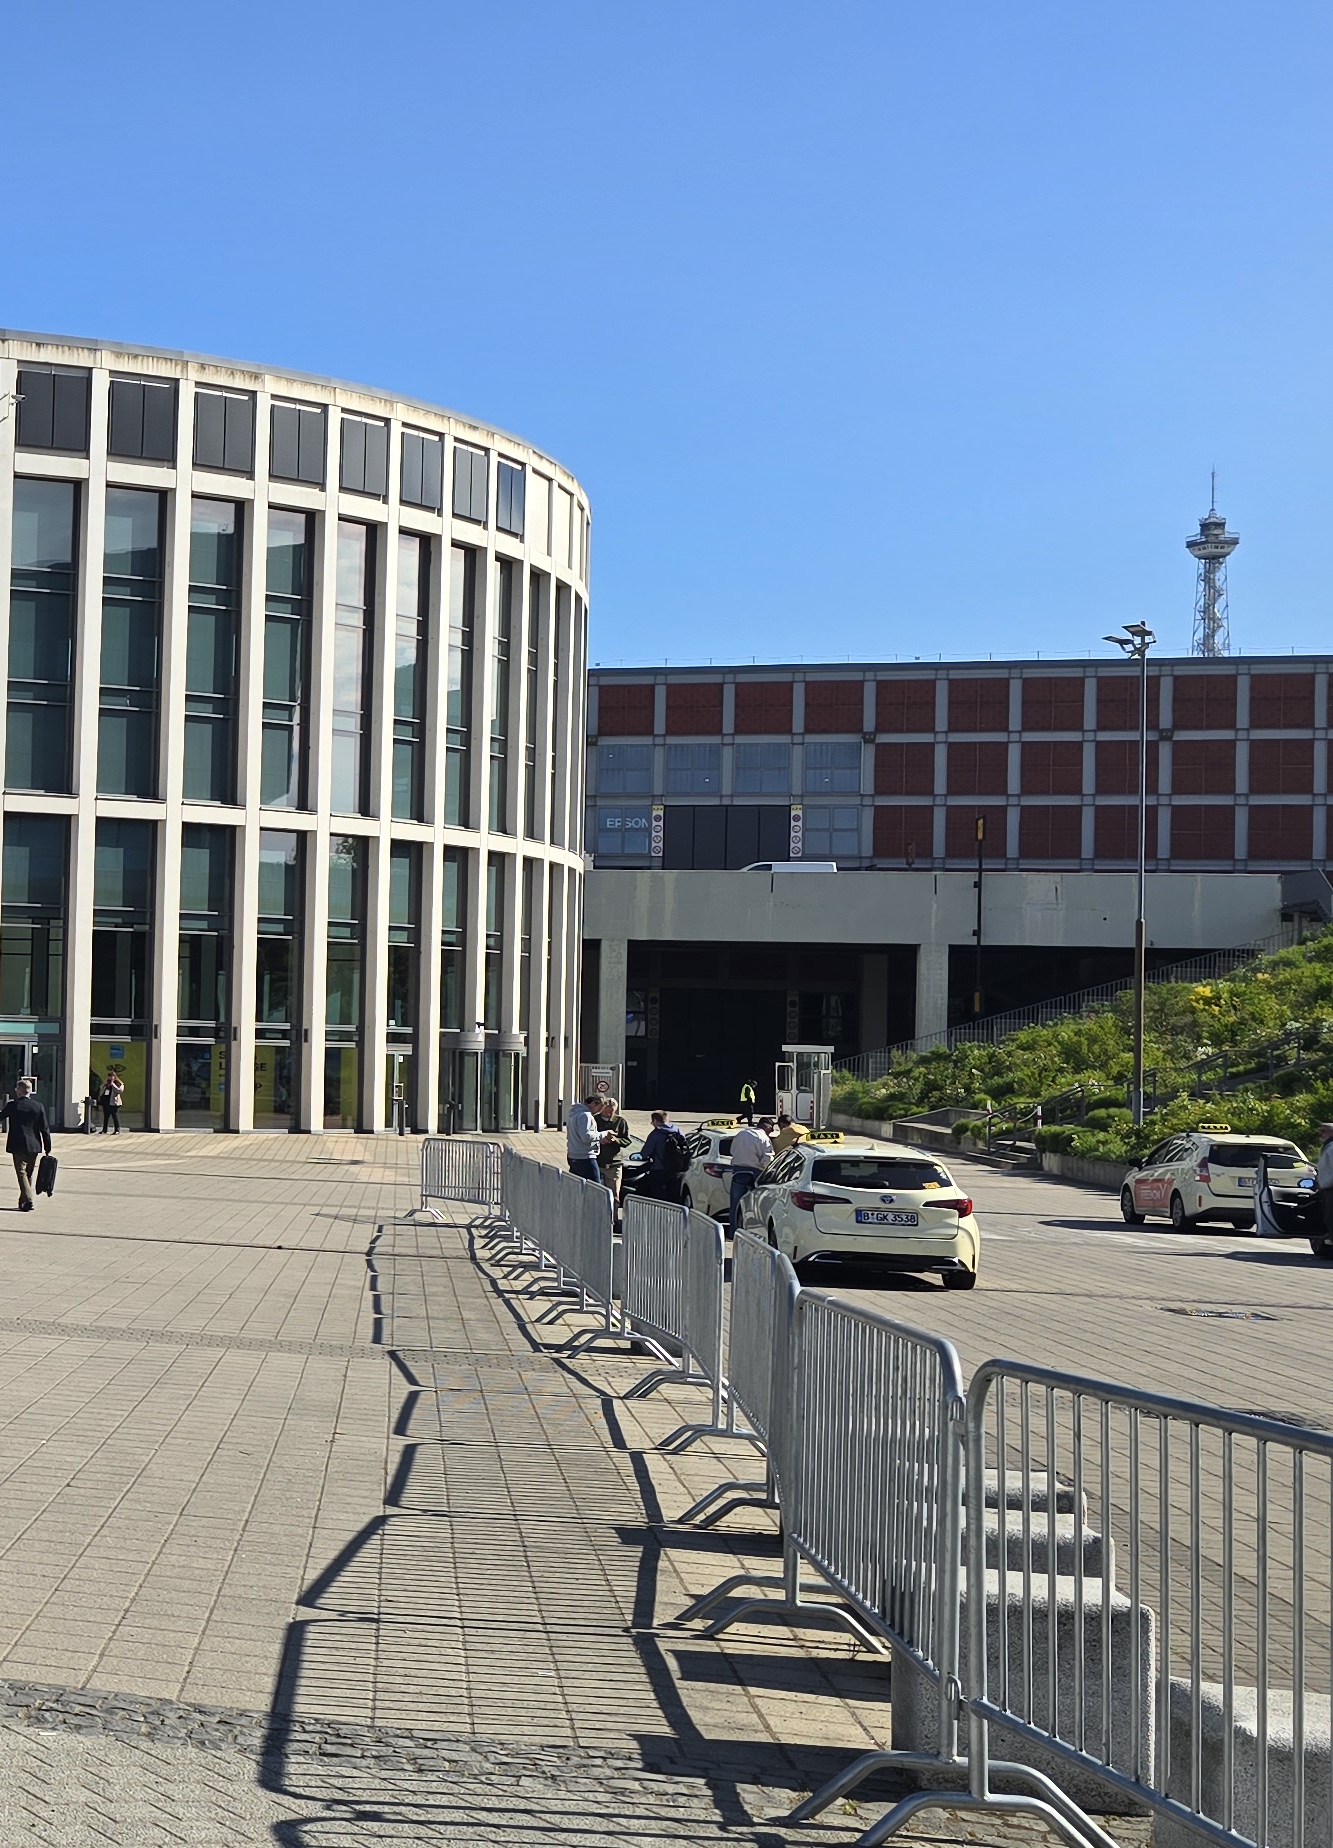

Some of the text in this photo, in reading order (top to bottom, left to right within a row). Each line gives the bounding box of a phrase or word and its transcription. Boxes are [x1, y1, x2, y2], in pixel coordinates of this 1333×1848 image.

[606, 817, 649, 829] EPSON
[862, 1213, 916, 1224] B GK 3538
